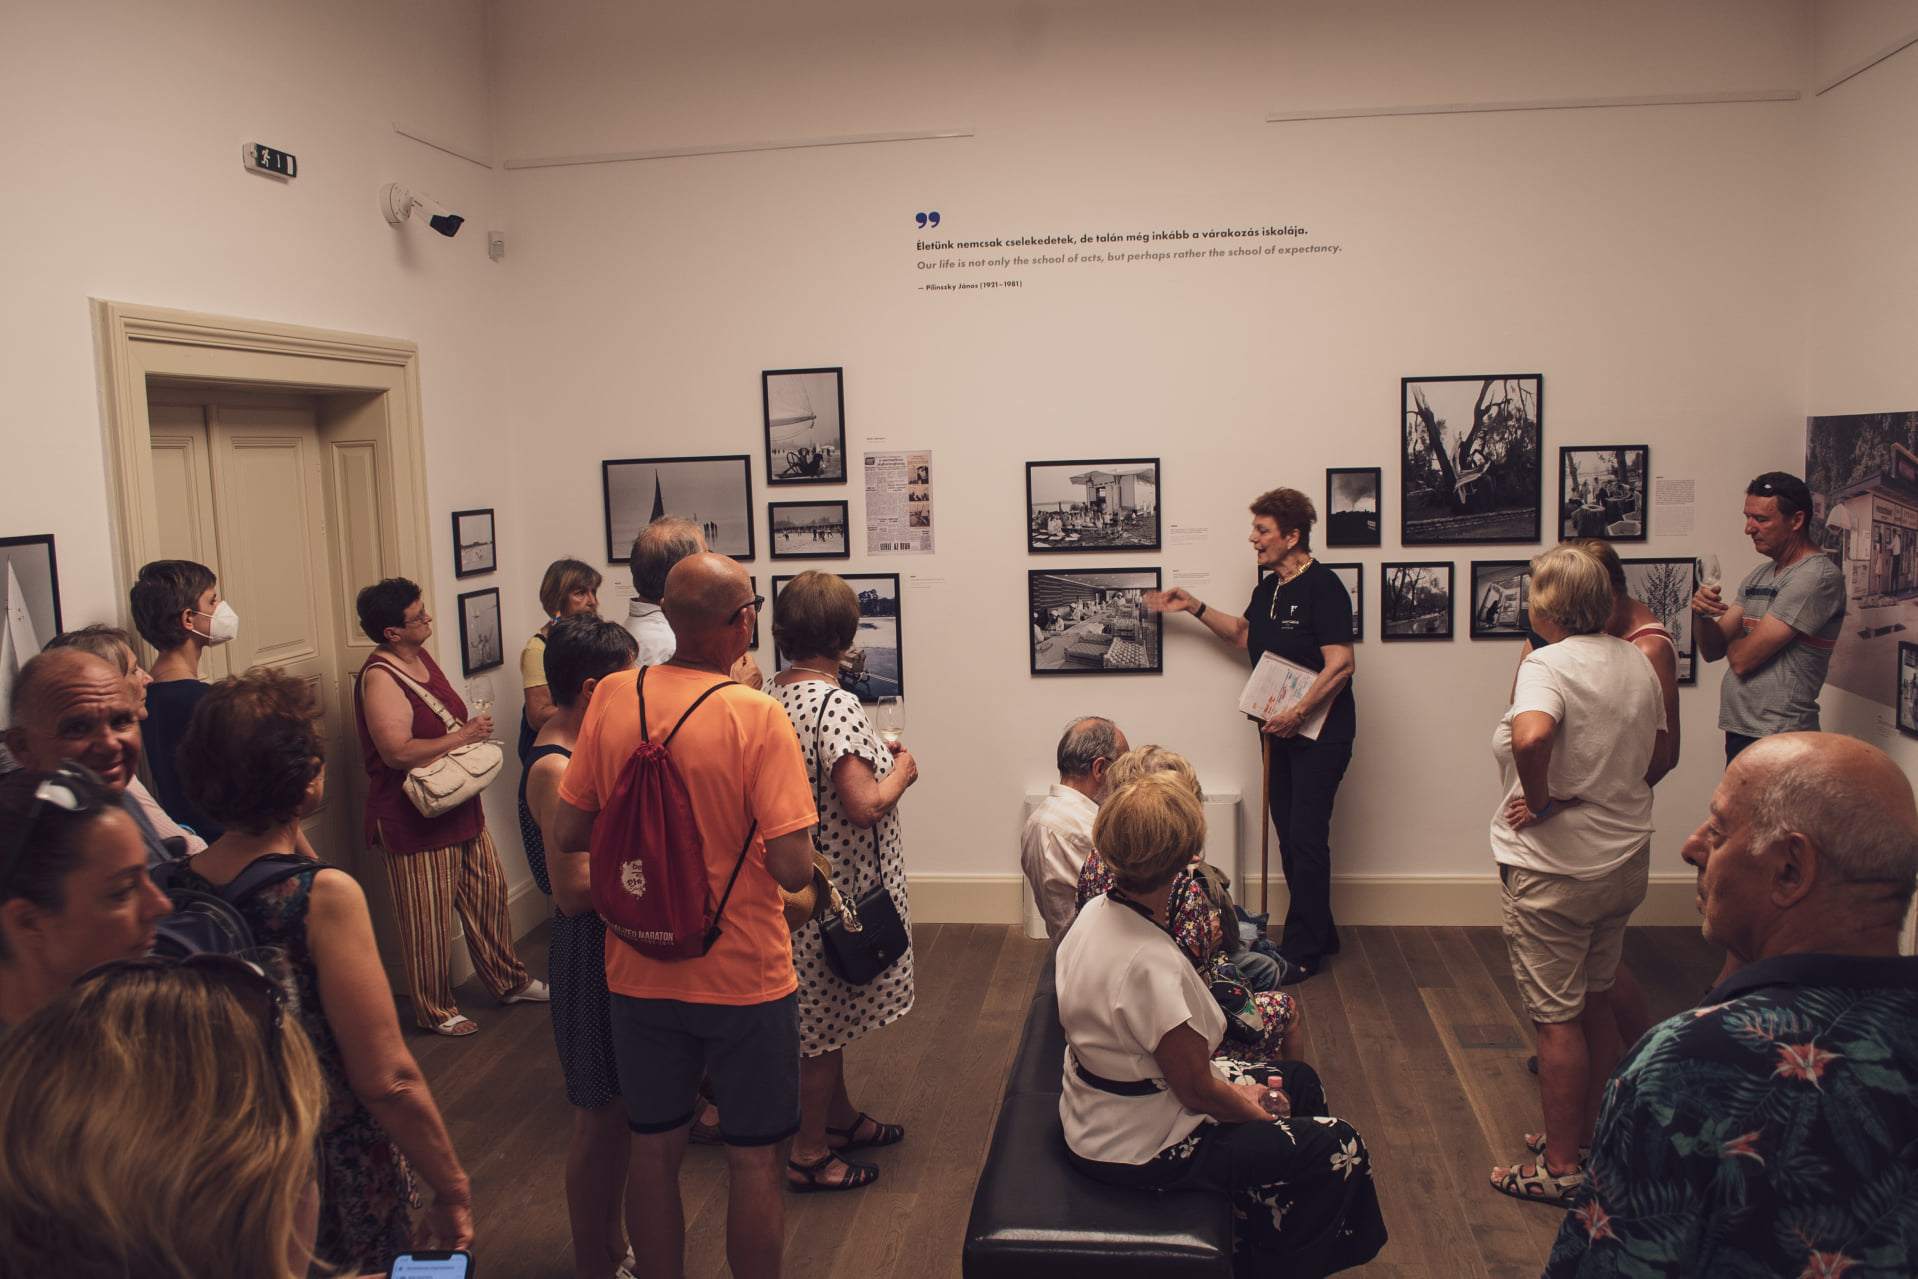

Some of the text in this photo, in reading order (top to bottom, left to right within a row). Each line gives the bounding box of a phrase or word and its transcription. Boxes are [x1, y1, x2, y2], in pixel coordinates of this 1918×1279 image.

[916, 225, 1308, 251] Életünk nemcsak cselekedetek, de talán még inkább a várakozás iskolája.
[917, 244, 1343, 270] Our life is not only the school of acts, but perhaps rather the school of expectancy.
[925, 283, 957, 292] Pilinszky
[958, 282, 979, 290] János
[638, 930, 674, 942] MARATON
